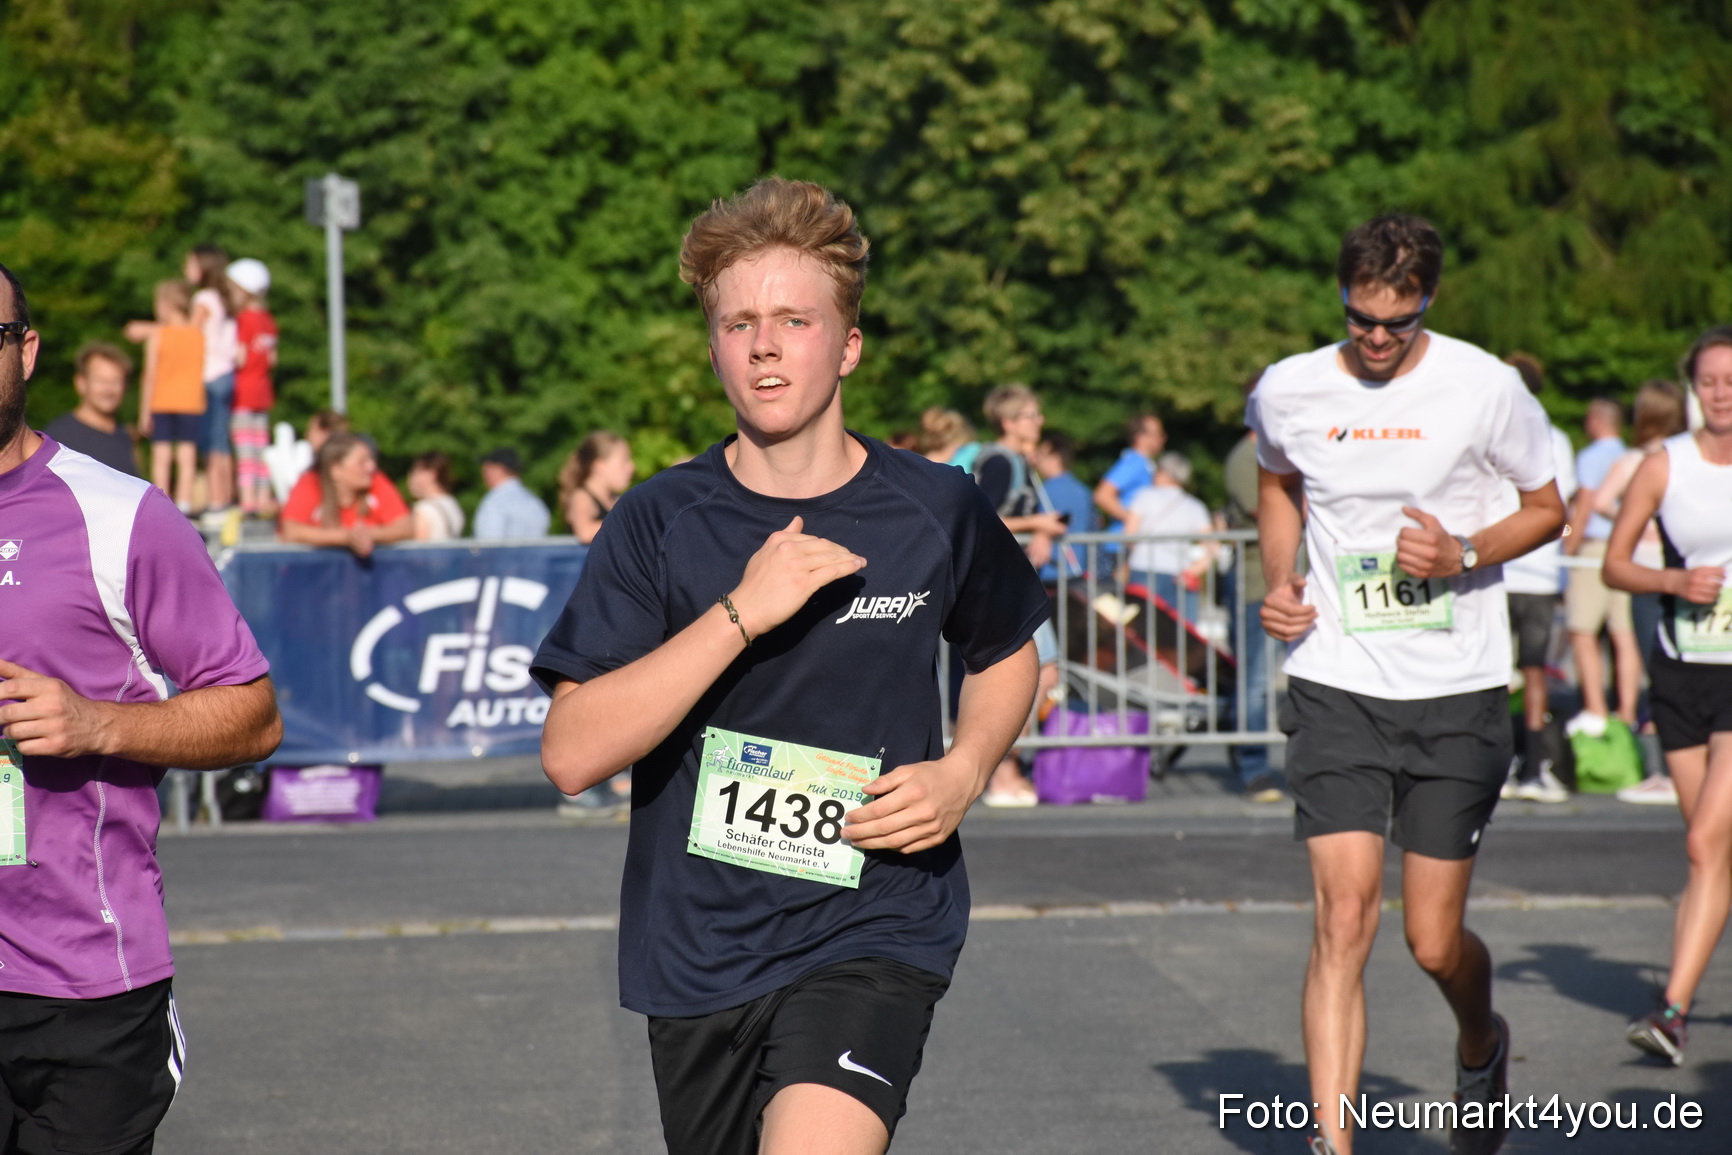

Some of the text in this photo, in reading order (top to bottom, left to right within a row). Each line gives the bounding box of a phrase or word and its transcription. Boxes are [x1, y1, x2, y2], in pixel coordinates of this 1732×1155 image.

[1352, 427, 1428, 440] KLEBL
[1355, 579, 1431, 609] 1161
[836, 596, 907, 624] JURA
[418, 633, 534, 694] Fis
[446, 696, 552, 729] AUTO
[727, 757, 795, 782] firmenlauf
[832, 787, 863, 802] 2019
[719, 781, 845, 845] 1438
[717, 840, 766, 858] Lebenshilfe
[768, 851, 811, 867] Neumarkt
[725, 828, 776, 848] Schäfer
[778, 839, 825, 858] Christa
